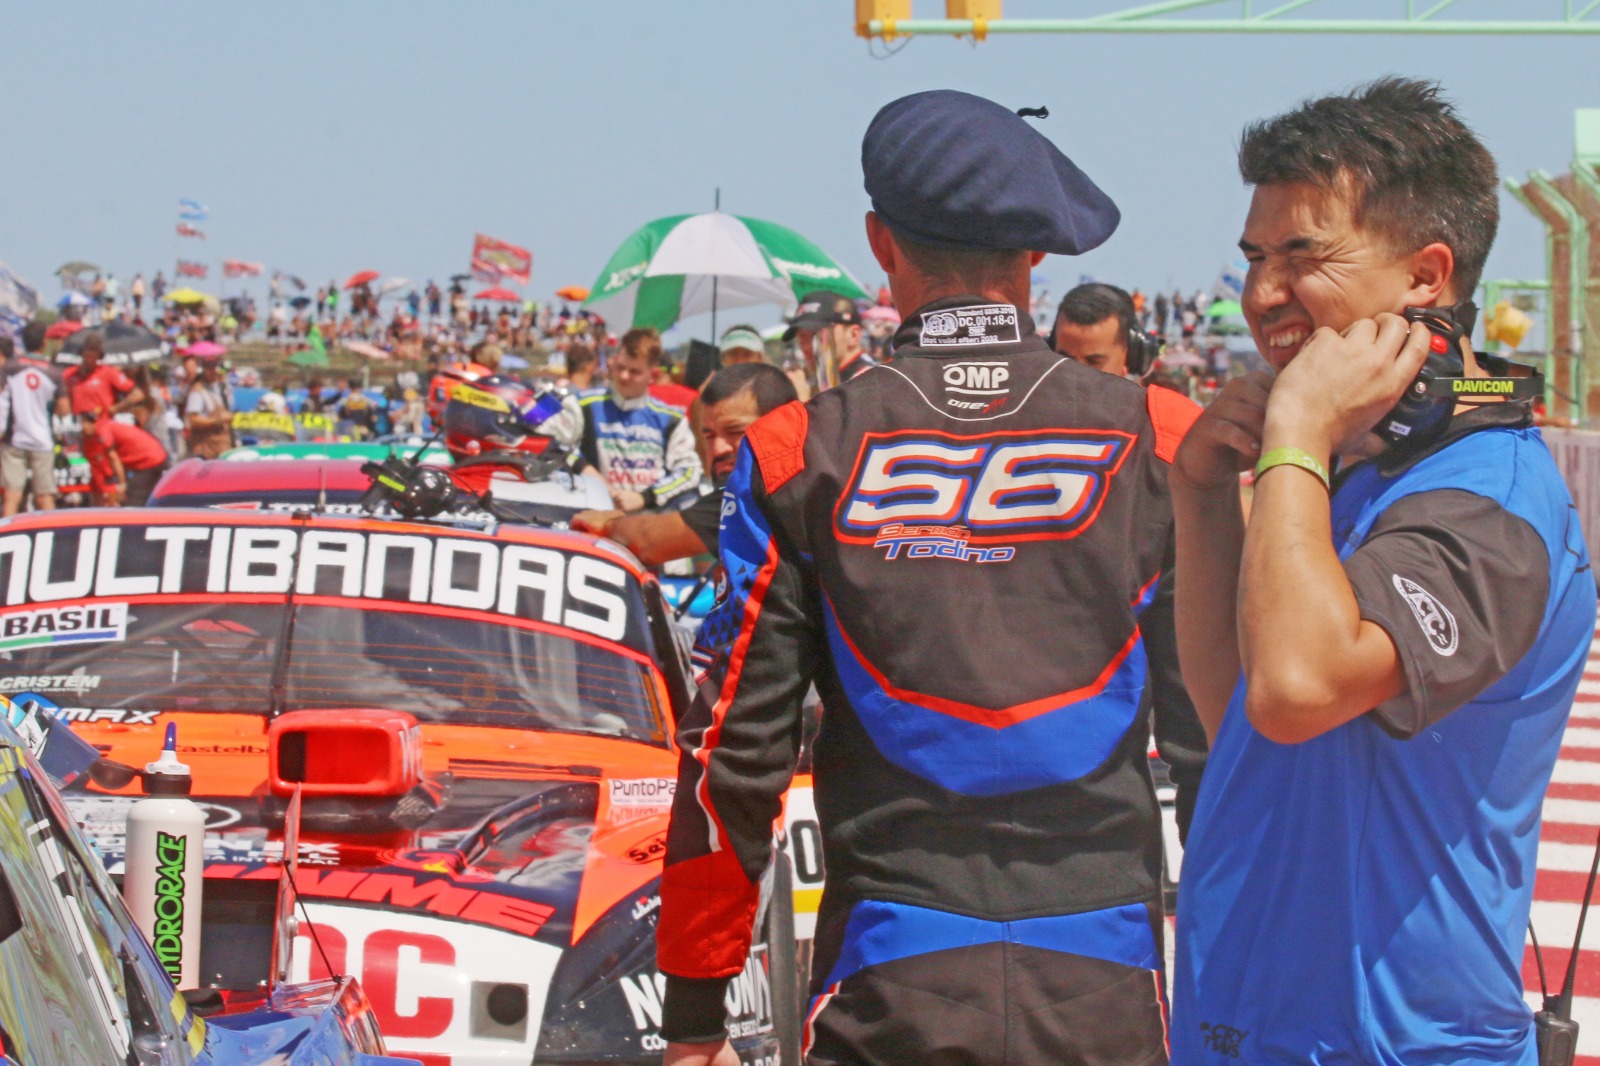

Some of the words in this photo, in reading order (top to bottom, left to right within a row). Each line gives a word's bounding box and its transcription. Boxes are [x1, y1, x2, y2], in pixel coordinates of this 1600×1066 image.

[943, 365, 1009, 389] OMP
[1453, 380, 1514, 393] DAVICOM
[843, 440, 1120, 528] 56
[874, 536, 1016, 563] Todino
